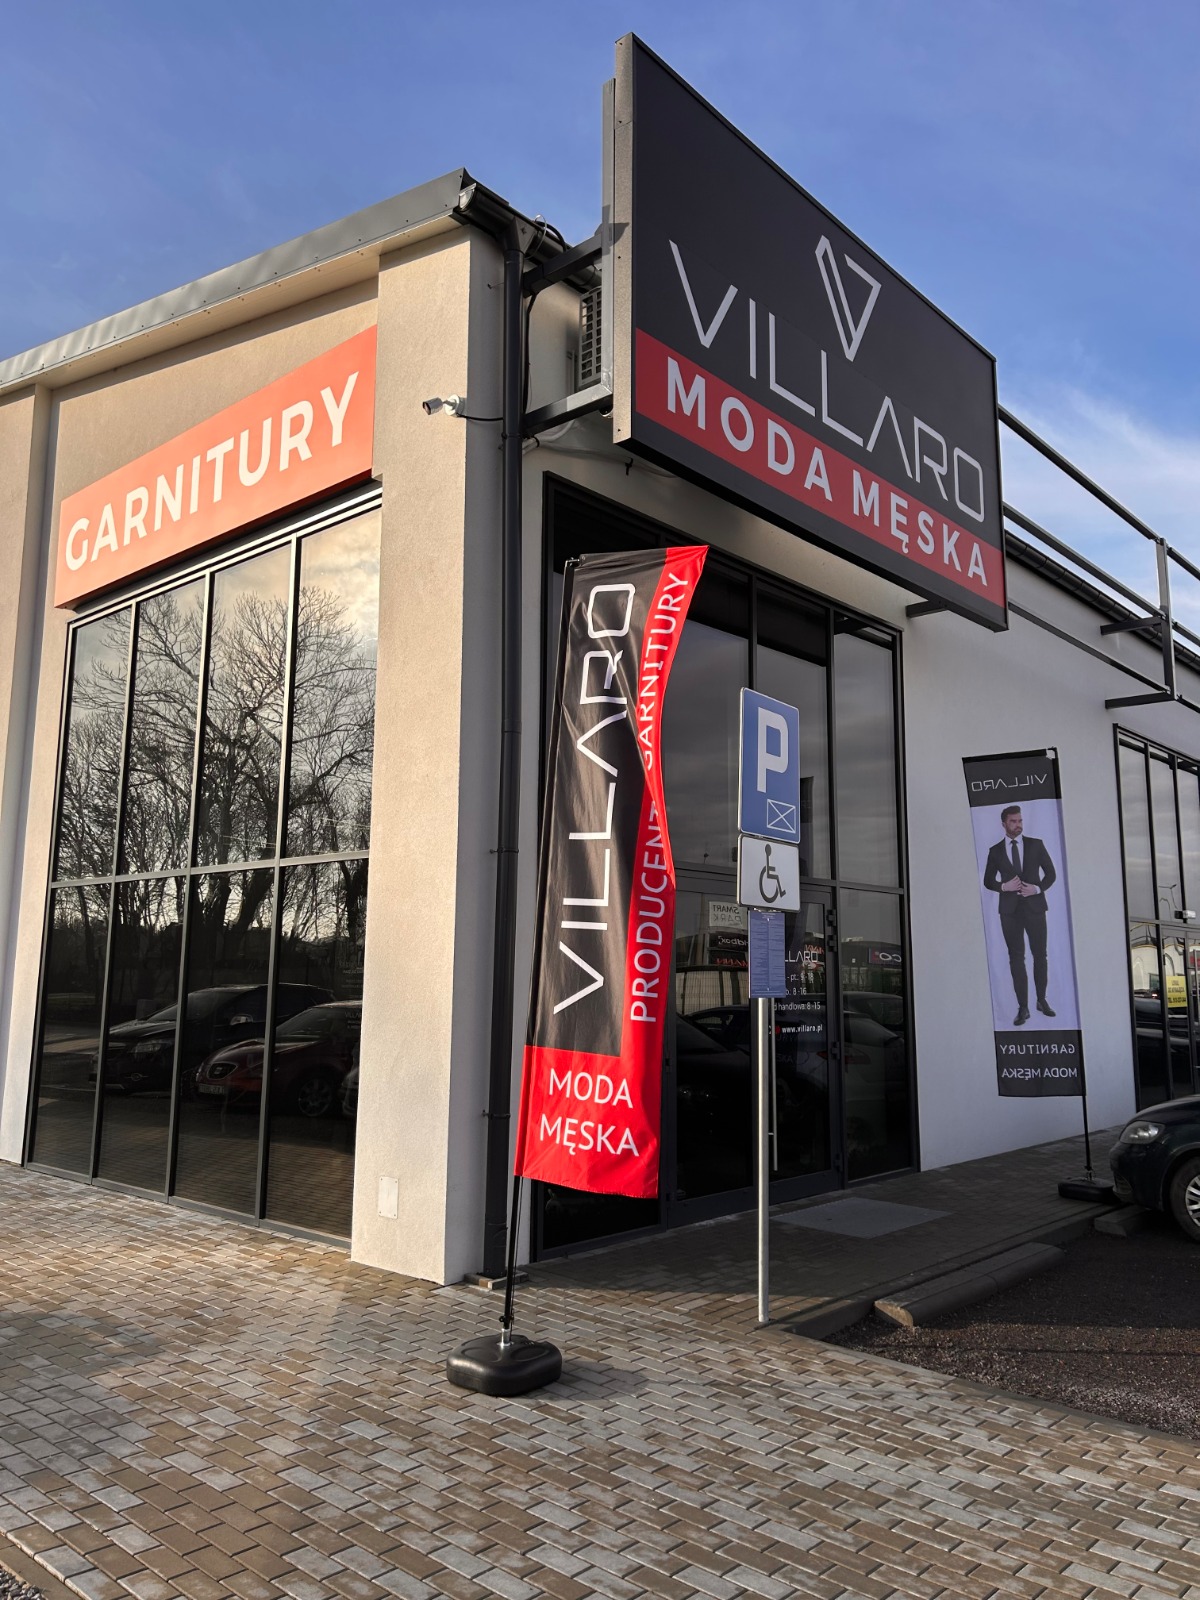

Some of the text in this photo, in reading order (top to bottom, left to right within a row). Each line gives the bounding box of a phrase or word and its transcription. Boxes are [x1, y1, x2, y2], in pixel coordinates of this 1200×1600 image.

[65, 371, 359, 572] GARNITURY
[667, 356, 988, 587] MODA MĘSKA
[668, 239, 985, 523] VILLARO
[553, 583, 636, 1015] VILLARO
[757, 706, 789, 793] P
[539, 1113, 640, 1156] MĘSKA
[549, 1068, 633, 1109] MODA
